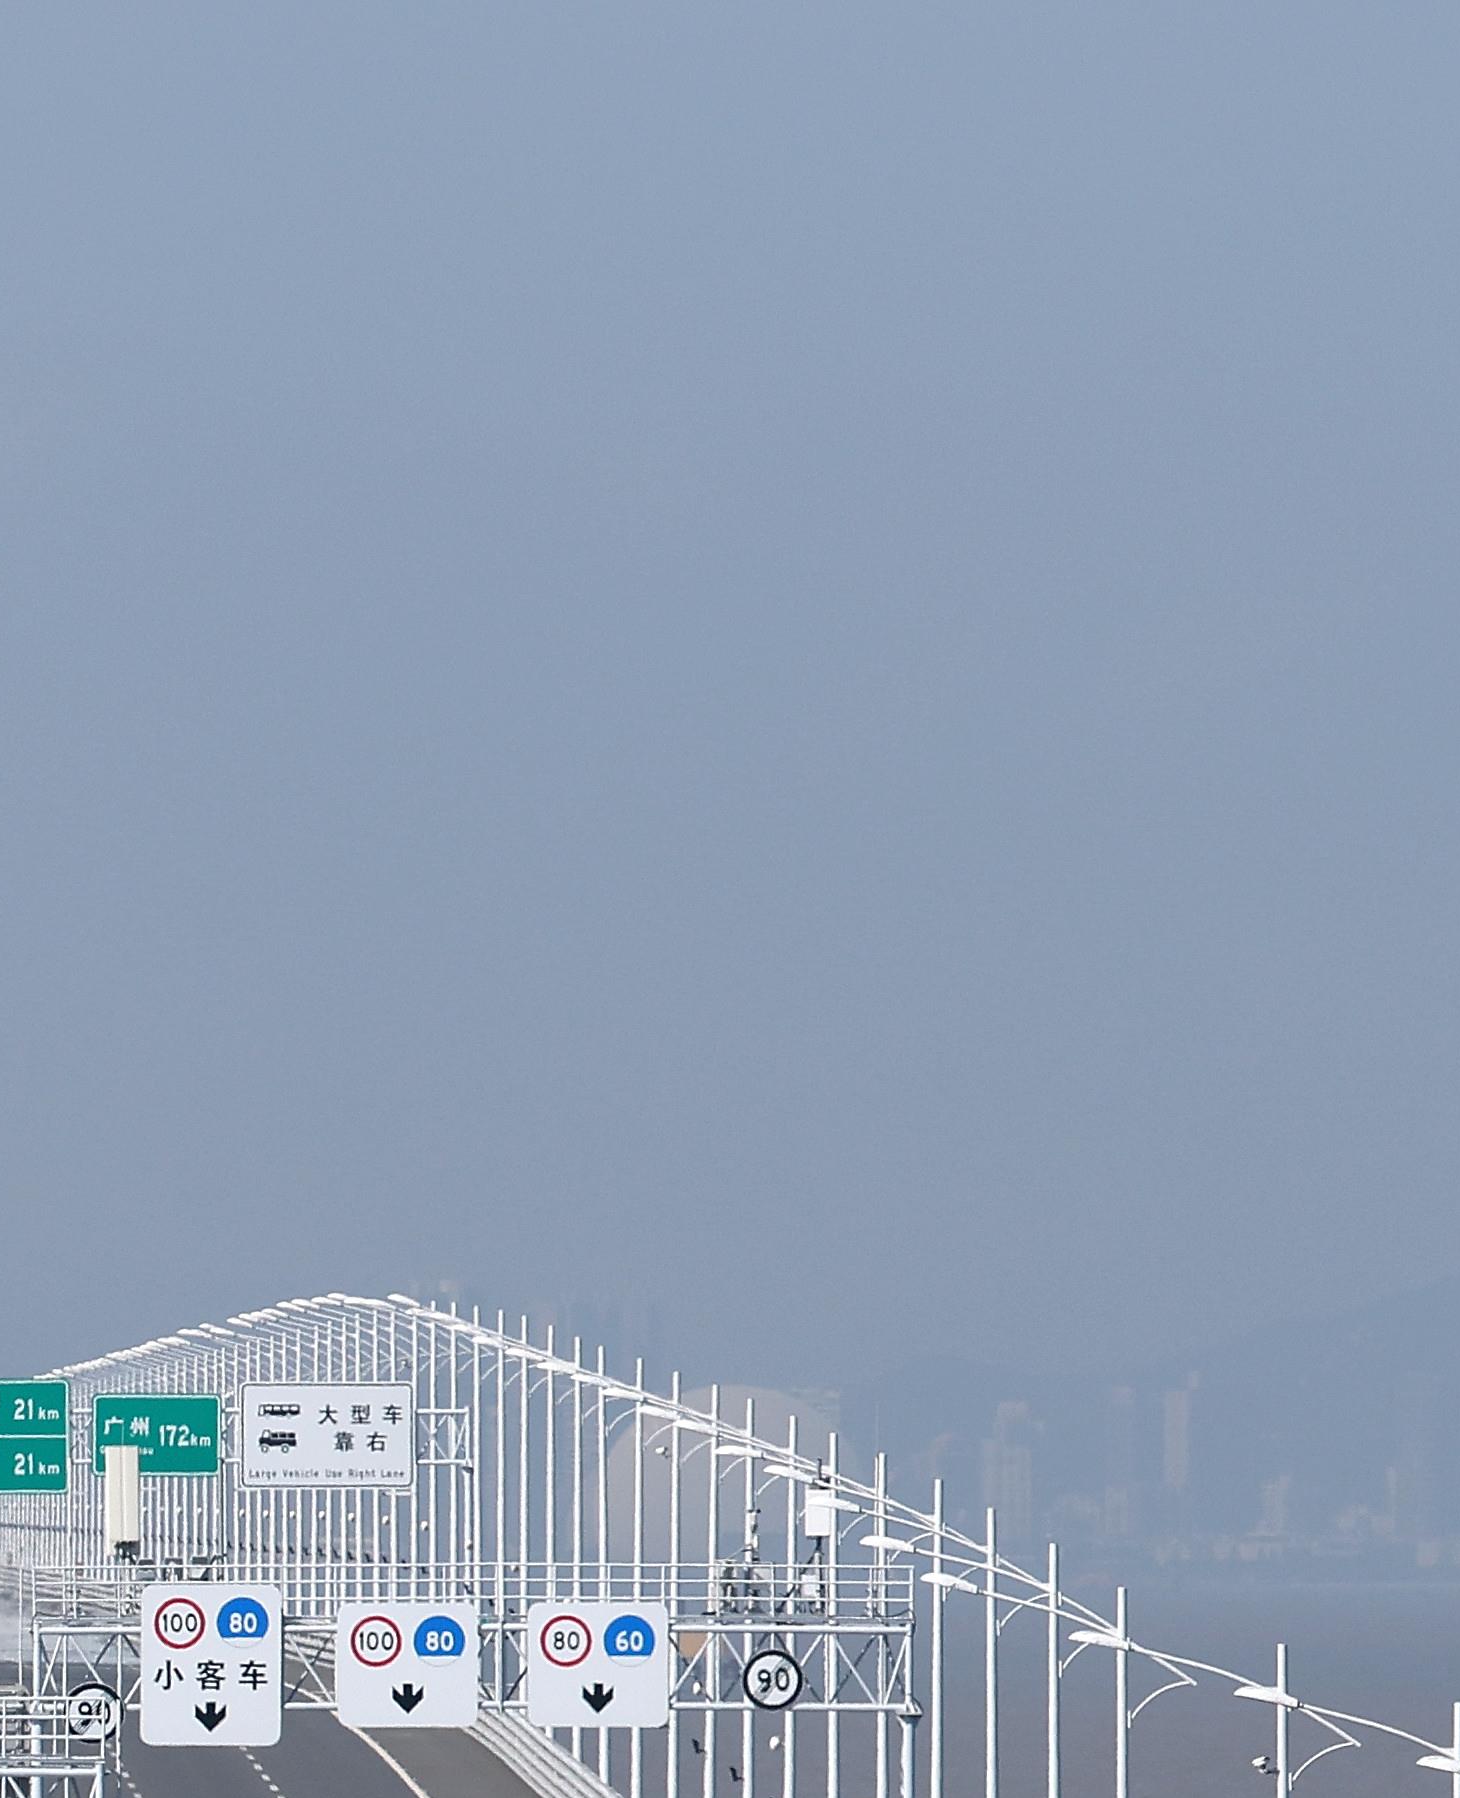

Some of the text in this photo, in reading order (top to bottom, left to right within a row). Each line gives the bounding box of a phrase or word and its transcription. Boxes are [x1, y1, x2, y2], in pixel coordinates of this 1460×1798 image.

[318, 1404, 403, 1425] 大型车
[103, 1415, 150, 1437] 广州
[334, 1431, 387, 1452] 靠右
[248, 1468, 405, 1480] Large Vehicle Use Right Lane
[162, 1613, 198, 1633] 100
[229, 1612, 257, 1633] 80
[359, 1631, 395, 1650] 100
[425, 1631, 454, 1651] 80
[553, 1631, 580, 1650] 80
[616, 1630, 643, 1651] 60
[154, 1660, 268, 1691] 小客车
[758, 1668, 789, 1692] 90
